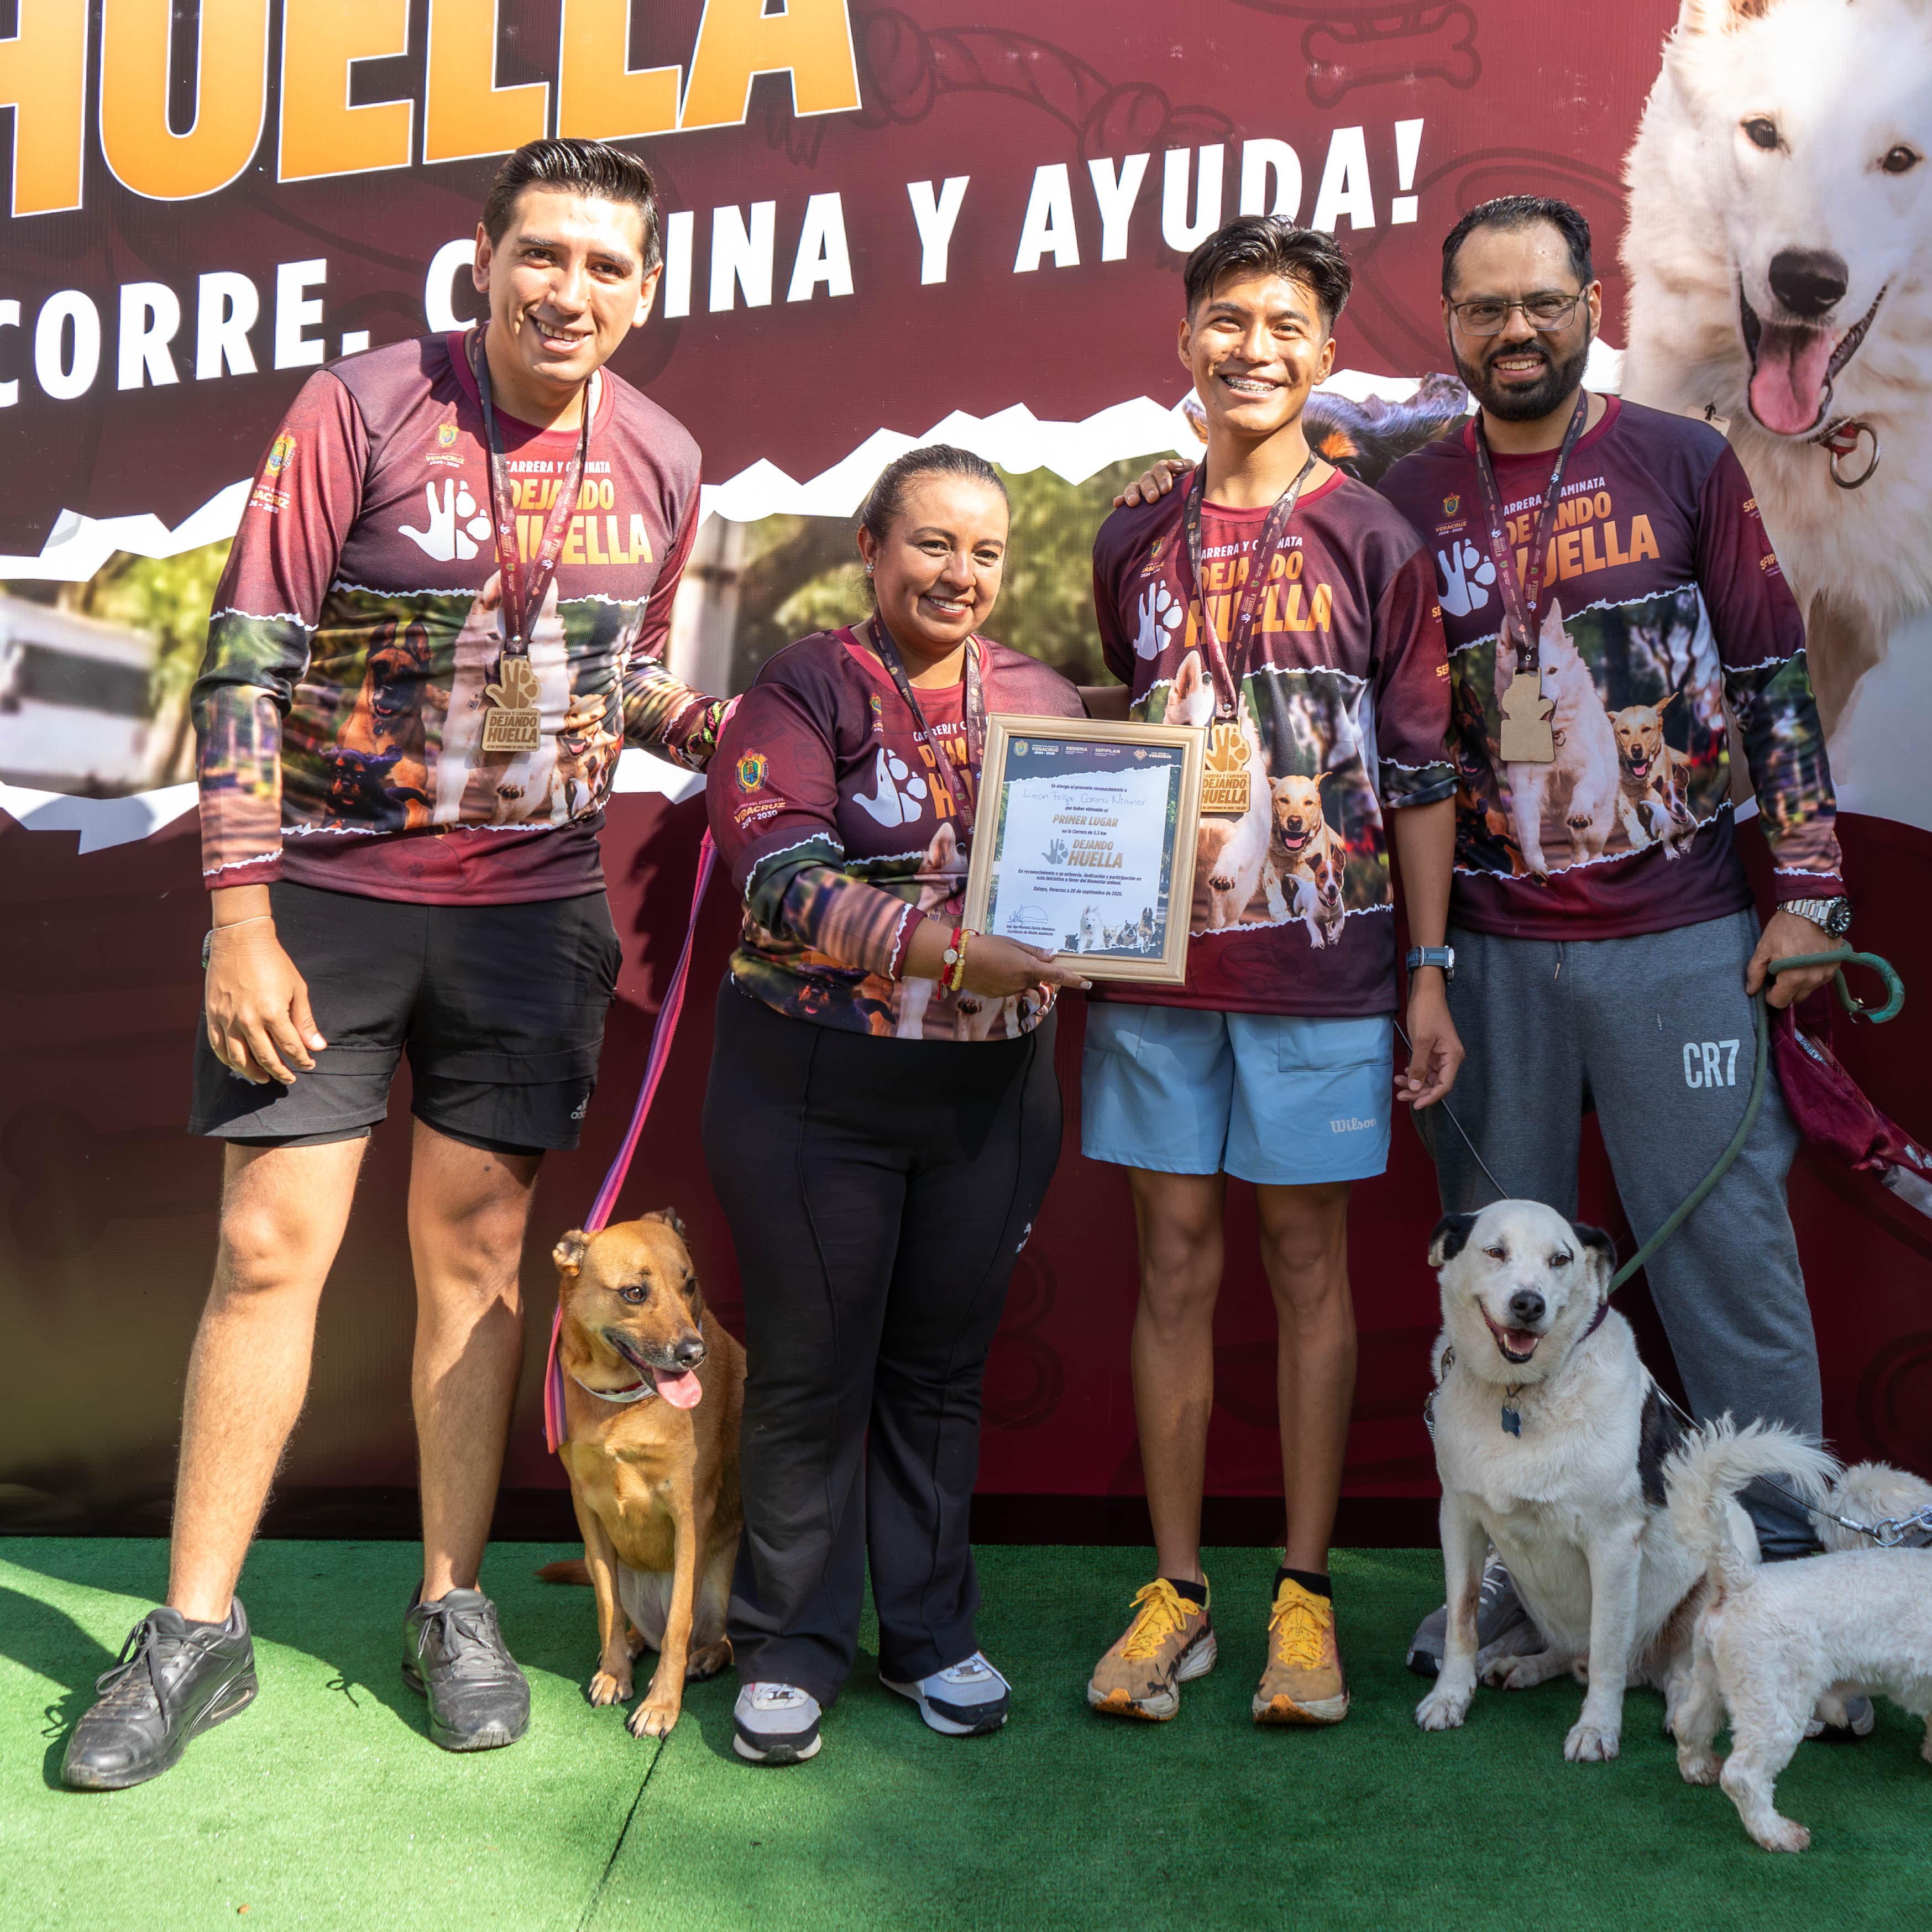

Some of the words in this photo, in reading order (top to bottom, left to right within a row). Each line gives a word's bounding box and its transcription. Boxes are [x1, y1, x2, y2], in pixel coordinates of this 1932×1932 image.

[425, 192, 855, 333] CINA
[907, 175, 971, 285] Y
[1014, 118, 1425, 274] AYUDA!
[557, 462, 563, 473] Y
[1504, 494, 1542, 516] ARRERA
[1561, 477, 1606, 498] AMINATA
[1436, 521, 1467, 532] VERACRUZ
[1201, 543, 1239, 561] ARRERA
[1243, 541, 1249, 552] Y
[489, 716, 537, 727] DEJANDO
[486, 727, 537, 743] HUELLA
[1203, 778, 1247, 789] DEJANDO
[1203, 789, 1247, 804] HUELLA
[757, 809, 778, 820] 2030
[1053, 814, 1087, 825] PRIMER
[1088, 816, 1119, 827] LUGAR
[1072, 839, 1114, 850] DEJANDO
[1067, 850, 1123, 868] HUELLA
[1683, 1039, 1740, 1088] CR7
[1329, 1117, 1376, 1133] Wilson
